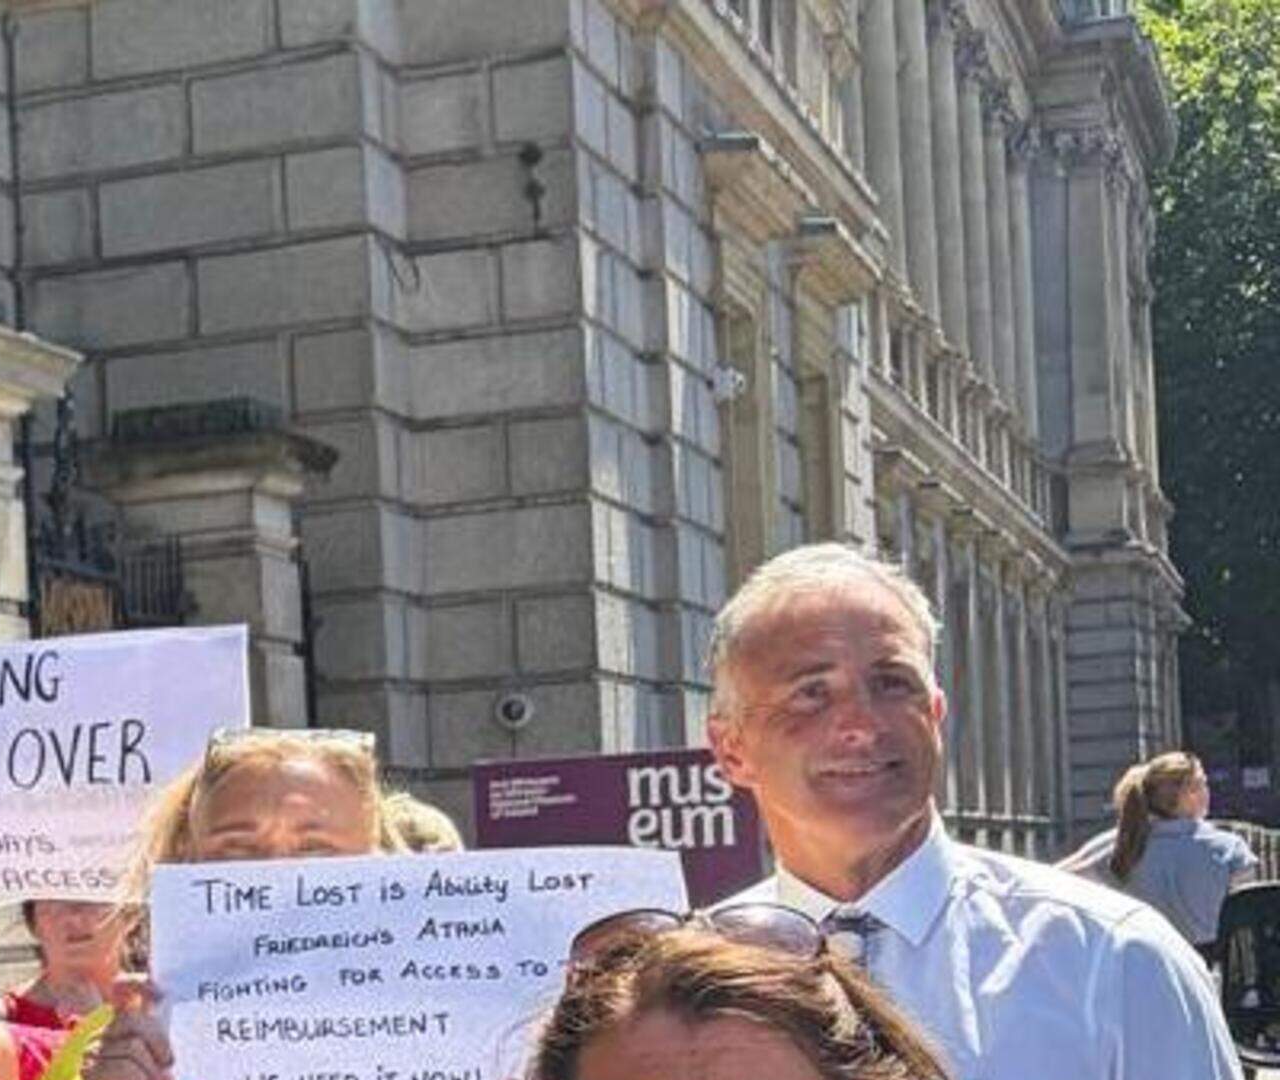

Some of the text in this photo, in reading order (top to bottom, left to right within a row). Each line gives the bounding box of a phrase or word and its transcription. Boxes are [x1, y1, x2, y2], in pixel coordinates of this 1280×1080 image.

[7, 719, 152, 791] OVER
[627, 763, 733, 806] mus
[627, 804, 736, 847] eum
[2, 867, 120, 892] ACCESS
[193, 878, 273, 914] TIME
[296, 875, 362, 906] LOST
[528, 870, 594, 892] LOST
[417, 917, 505, 940] ATAXIA
[198, 958, 548, 1001] FIGHTING FOR ACCESS TO
[217, 1012, 452, 1043] REIMBURSEMENT
